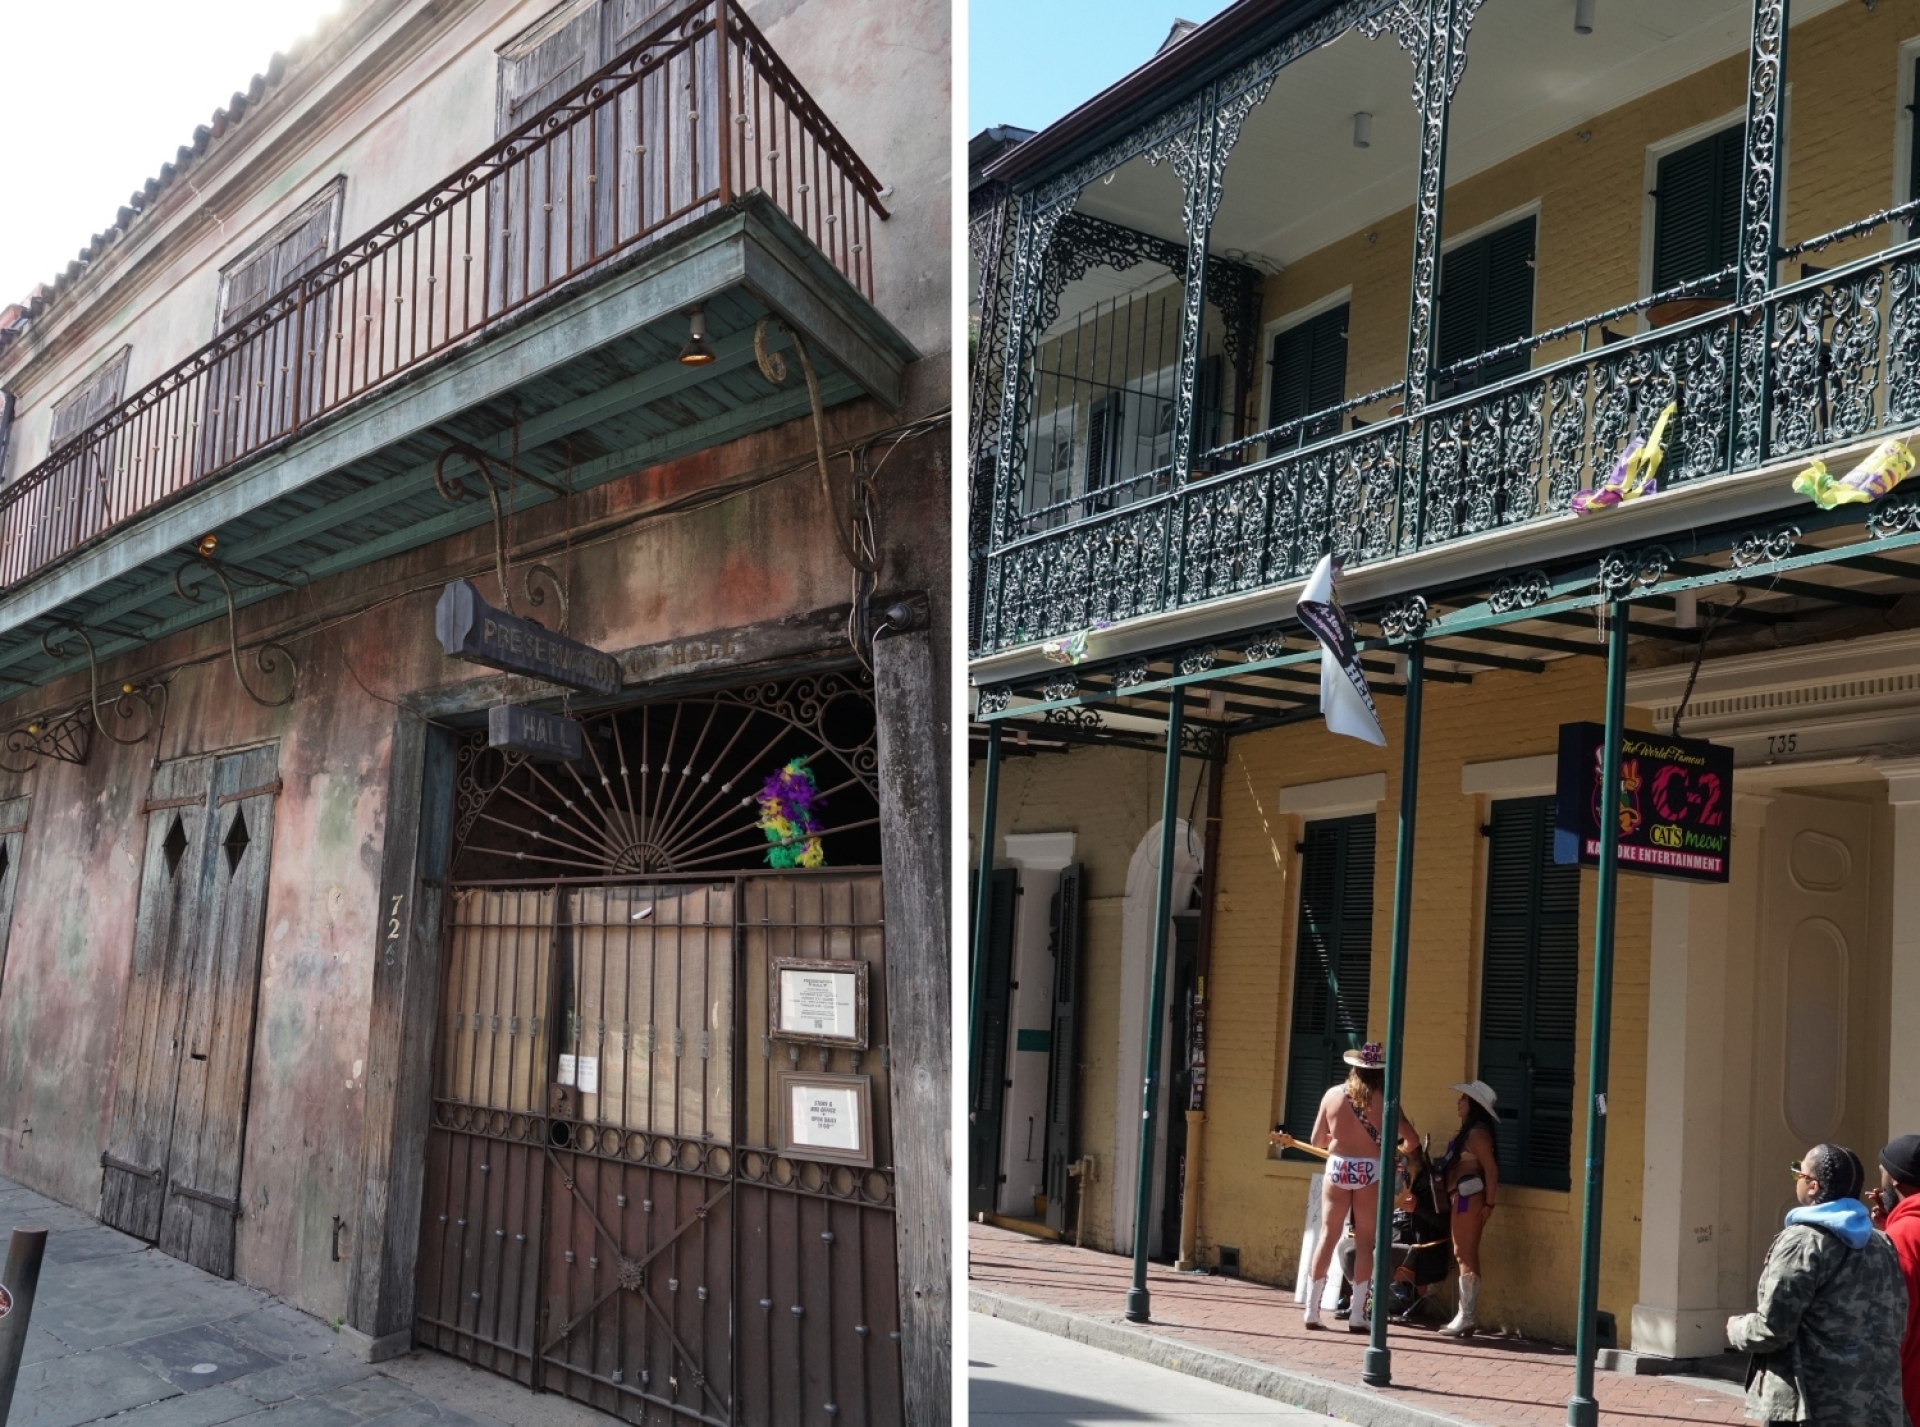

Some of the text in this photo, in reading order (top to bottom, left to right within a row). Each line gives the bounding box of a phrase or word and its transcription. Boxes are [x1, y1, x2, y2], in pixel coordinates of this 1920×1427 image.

[483, 618, 617, 684] PRESERVATION
[671, 640, 736, 666] HALL
[522, 714, 572, 749] HALL
[1767, 734, 1797, 754] 735
[1622, 738, 1707, 766] The World-Famous
[1652, 765, 1723, 826] C-2
[1650, 825, 1723, 851] CAT'S meow
[1587, 840, 1722, 872] KAOKE ENTERTAINMENT
[1333, 1160, 1374, 1173] NAKED
